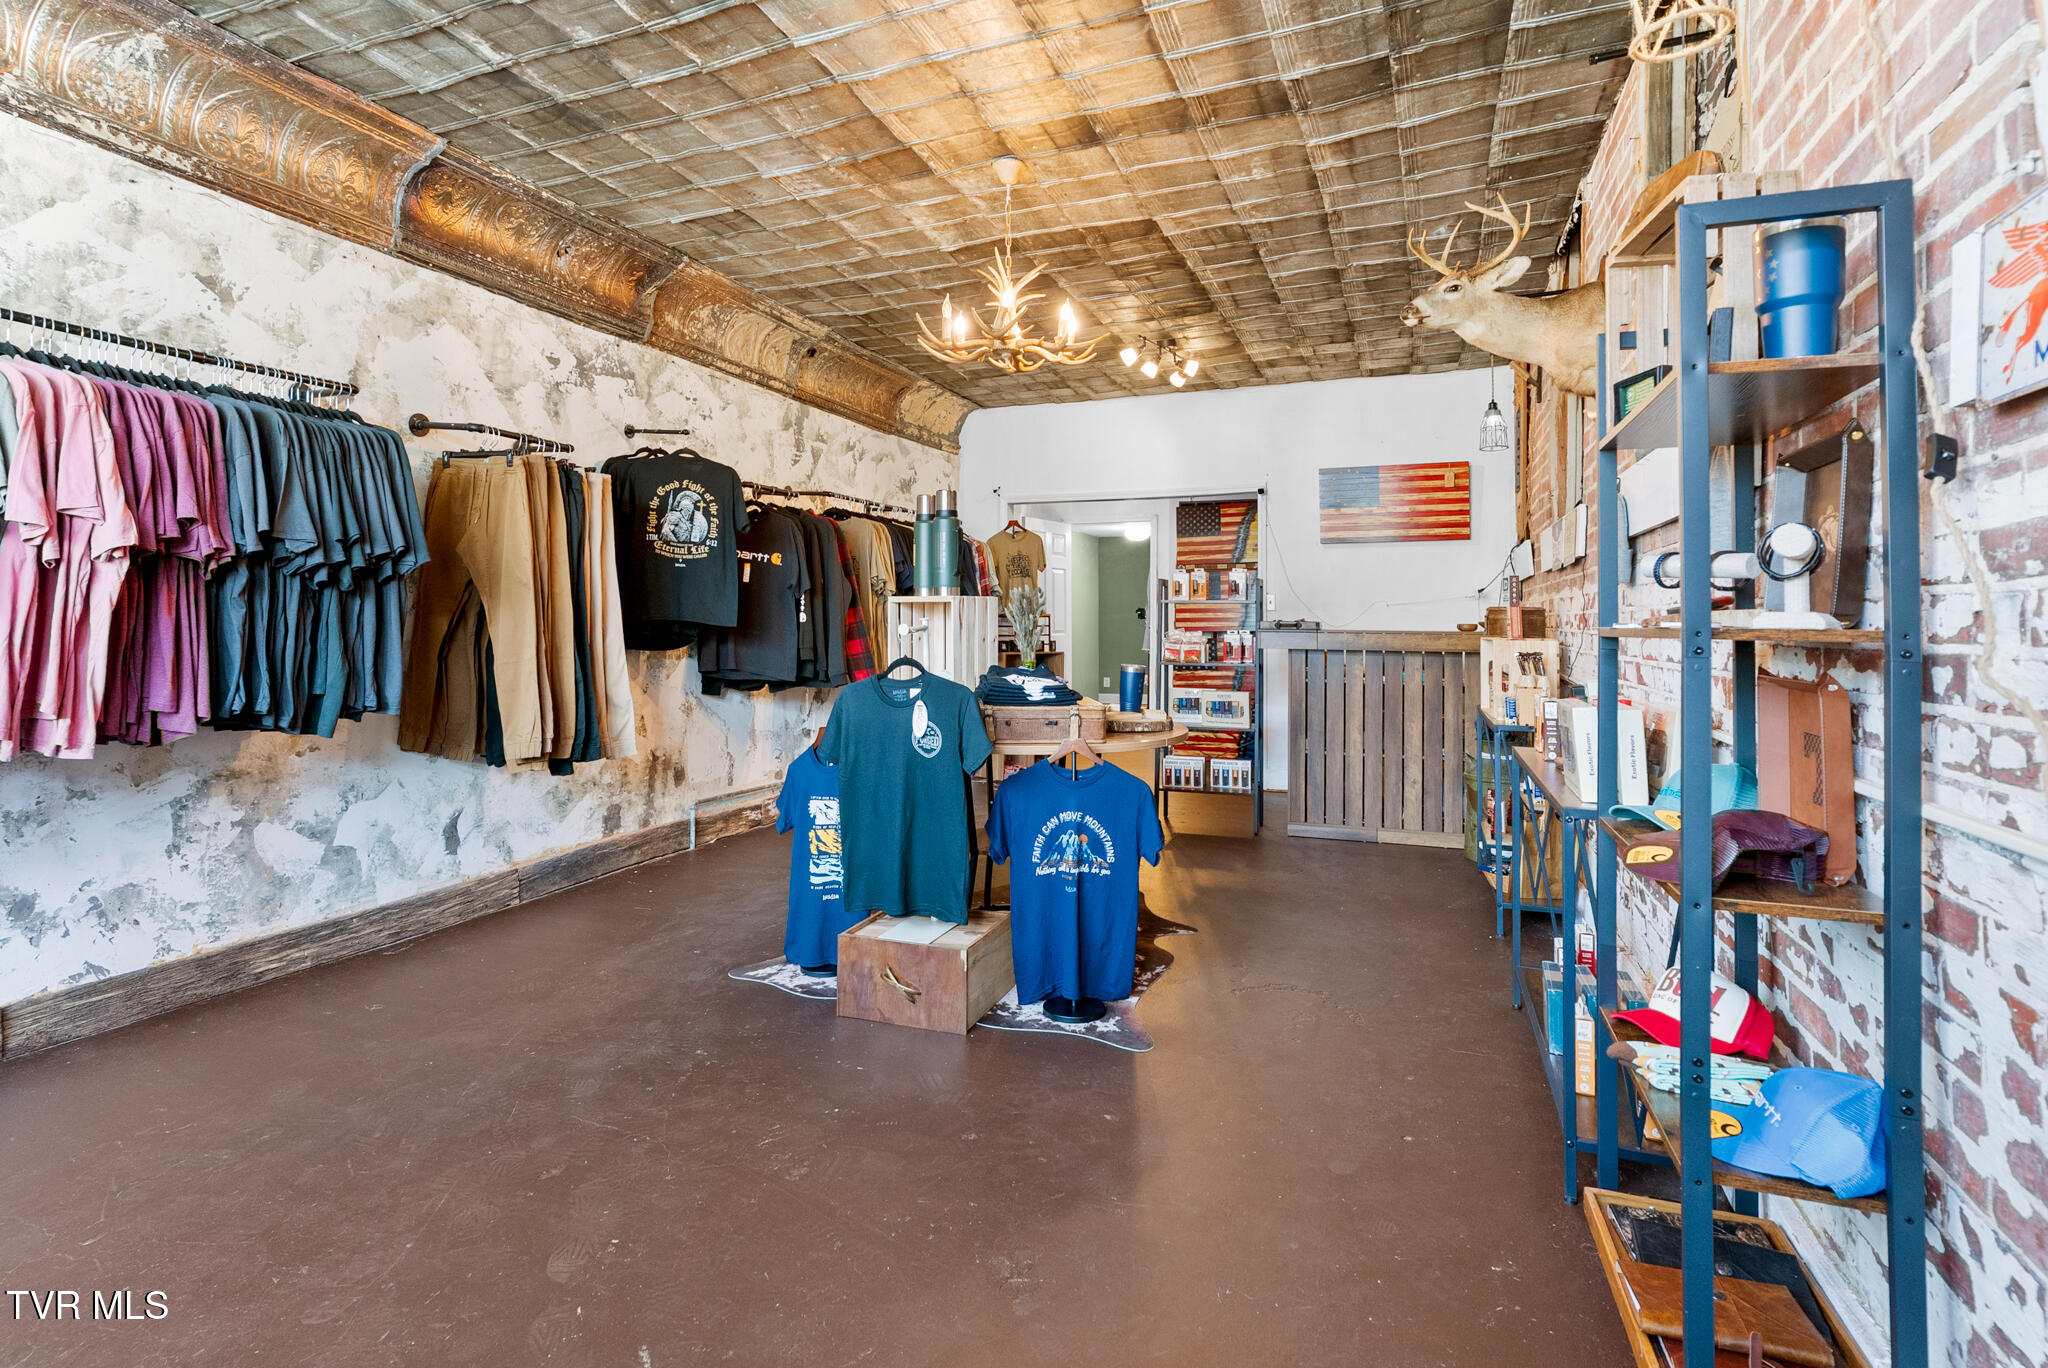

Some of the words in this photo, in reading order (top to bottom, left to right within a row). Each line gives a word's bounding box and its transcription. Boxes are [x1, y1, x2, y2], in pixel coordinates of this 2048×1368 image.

[657, 480, 680, 496] Good
[682, 479, 706, 494] Fight
[649, 496, 660, 509] the
[704, 493, 715, 502] of
[709, 502, 719, 516] the
[646, 511, 658, 532] Fight
[708, 517, 720, 539] Faith
[654, 540, 688, 554] Eternal
[691, 544, 710, 555] Life
[1032, 834, 1046, 863] FAITH
[1041, 815, 1060, 836] CAN
[1059, 811, 1084, 824] MOVE
[1083, 815, 1116, 863] MOUNTAINS
[1035, 866, 1057, 877] Nothing
